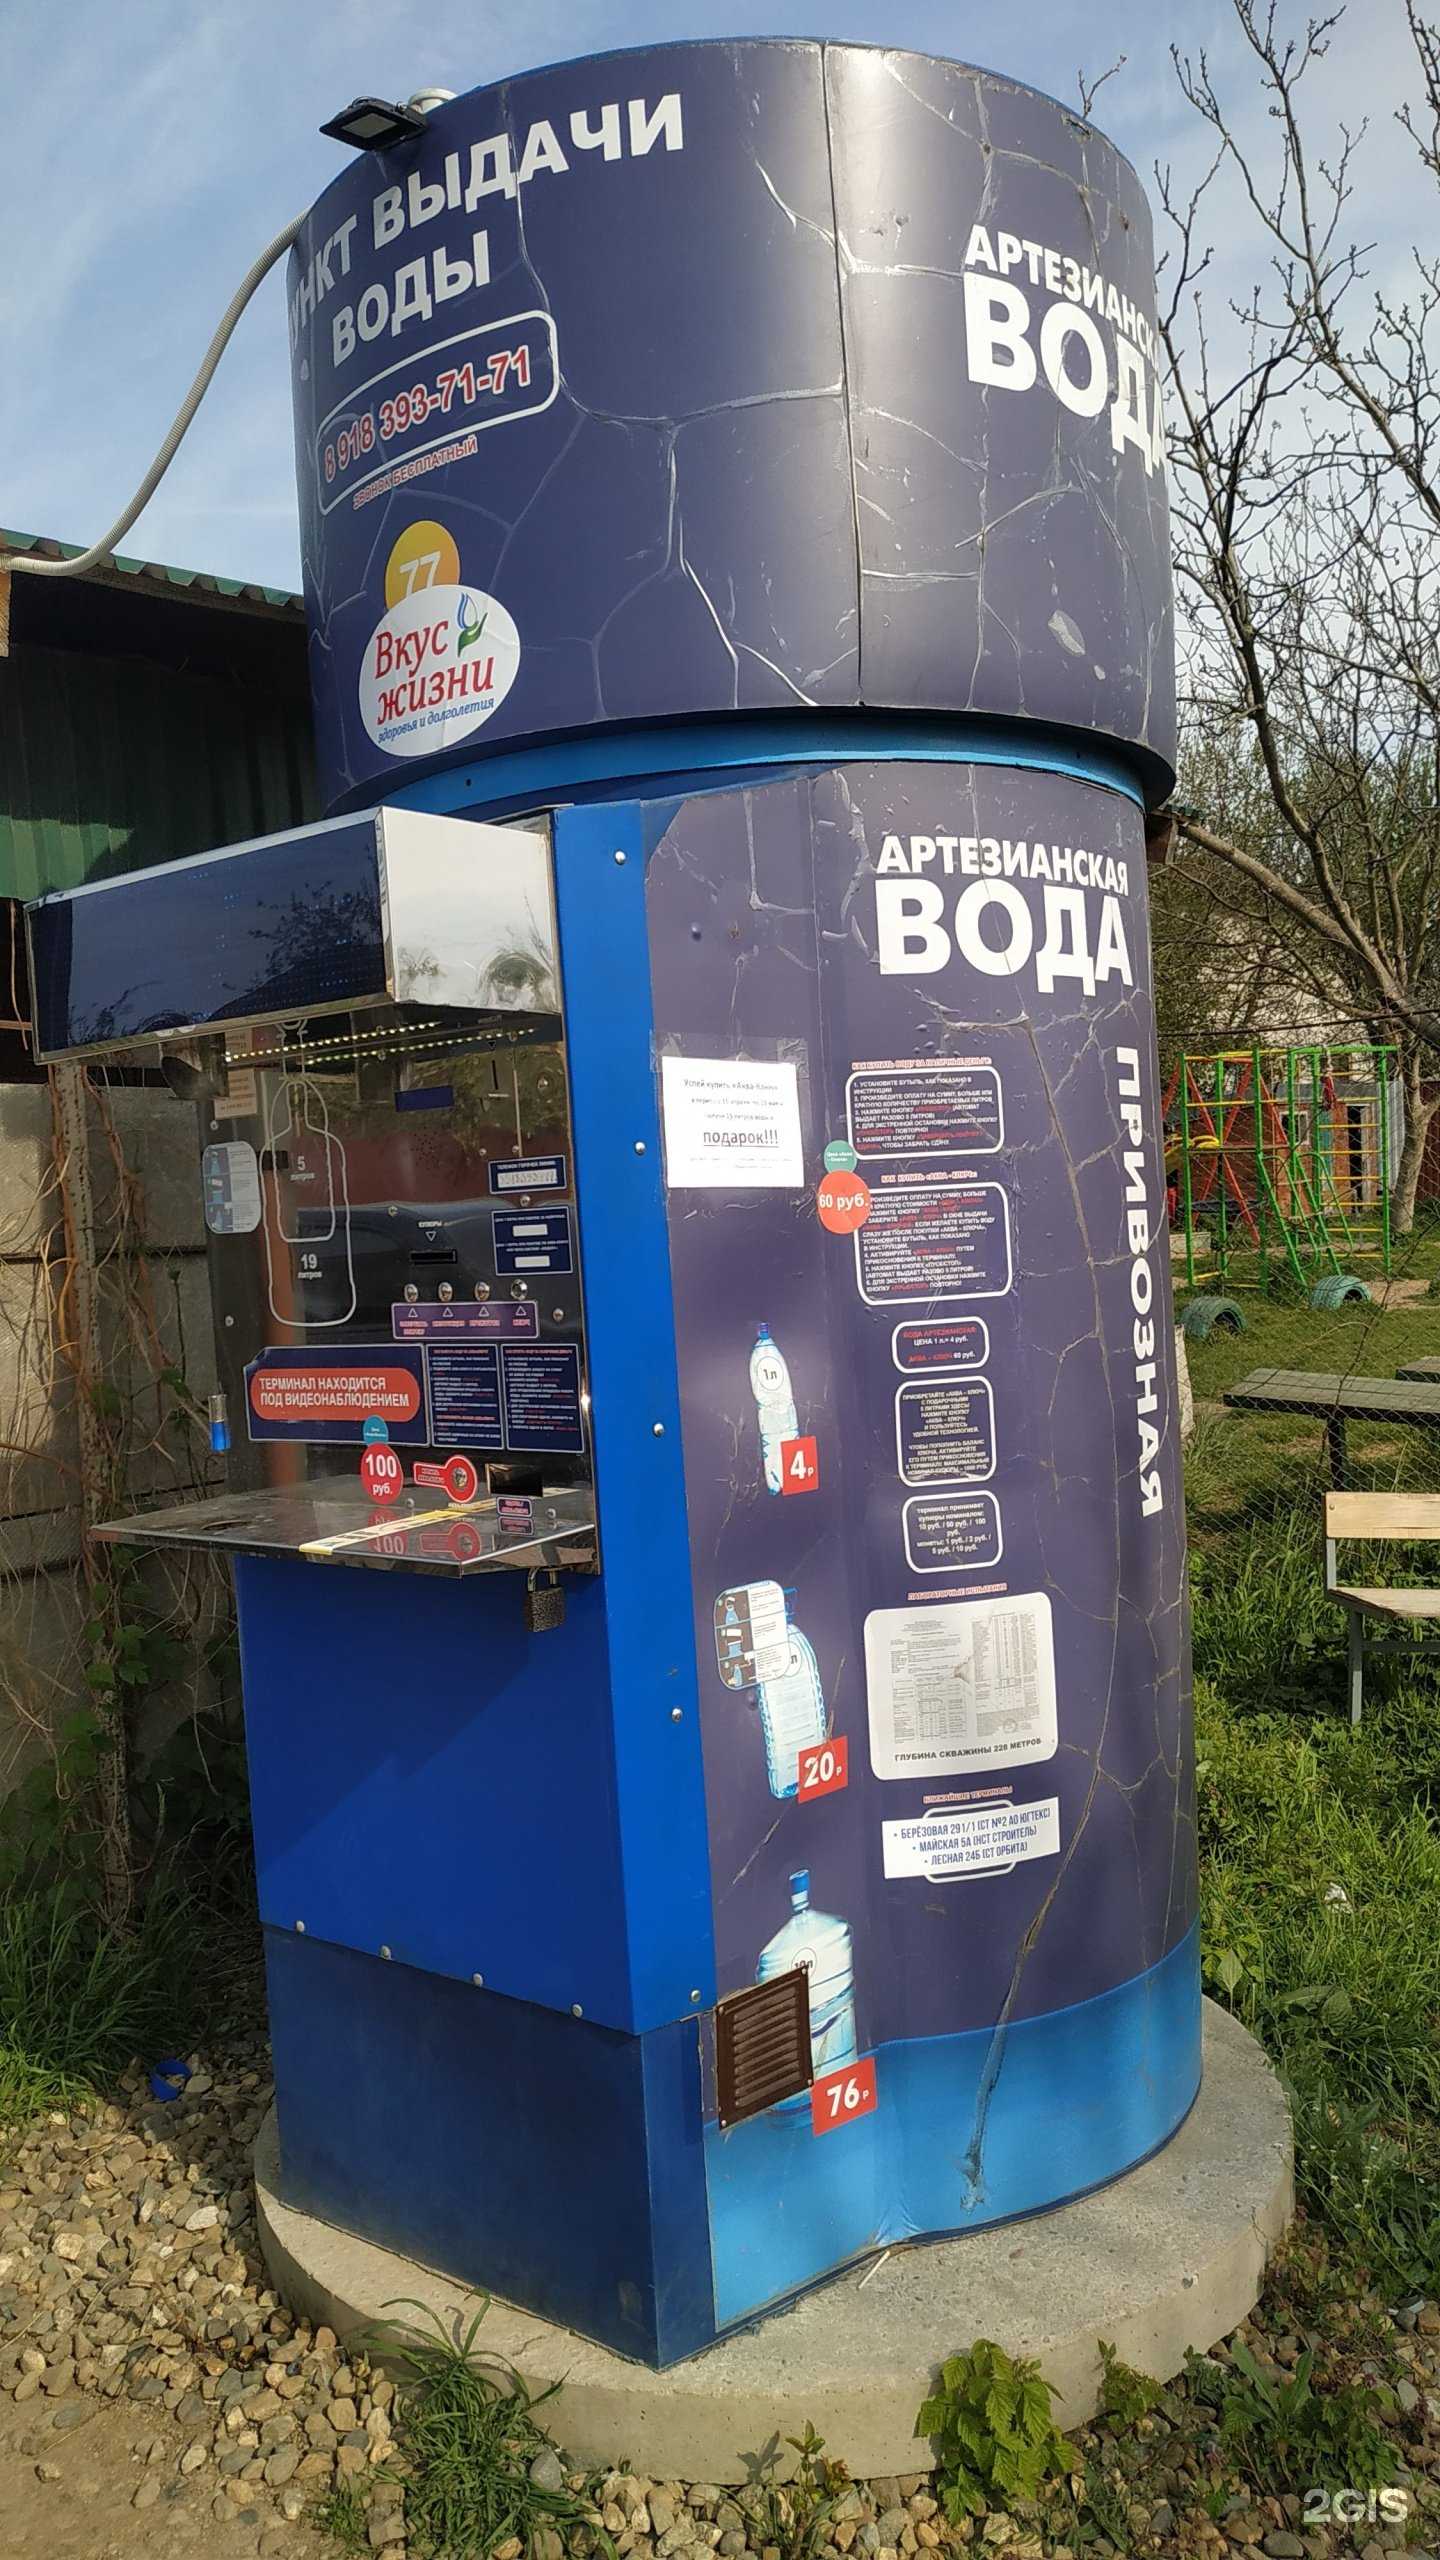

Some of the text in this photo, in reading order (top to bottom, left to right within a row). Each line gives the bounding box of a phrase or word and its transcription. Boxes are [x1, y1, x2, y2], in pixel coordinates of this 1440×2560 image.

[373, 94, 683, 250] ВЫДАЧИ
[332, 230, 491, 368] ВОДЫ
[965, 224, 1156, 362] АРТЕЗИАНСК
[325, 344, 530, 483] 8 918 393-71-71
[392, 433, 478, 487] БЕСПЛАТНЫЙ
[399, 551, 441, 598] 77
[374, 620, 449, 679] Вкус
[419, 714, 427, 729] и
[427, 698, 494, 726] долголетия
[876, 836, 1128, 896] АРТЕЗИАНСКАЯ
[875, 878, 1133, 996] ВОДА
[703, 1129, 779, 1147] подарок!!!
[297, 1156, 306, 1171] 5
[819, 1192, 869, 1211] 60 руб.
[301, 1254, 317, 1269] 19
[1116, 1046, 1163, 1518] ПРИВОЗНАЯ
[914, 1338, 932, 1346] ЦЕНА
[955, 1335, 968, 1343] руб.
[259, 1377, 386, 1392] ТЕРМИНАЛ НАХОДИТСЯ
[260, 1393, 409, 1408] ПОД ВИДЕОНАБЛЮДЕНИЕМ
[365, 1454, 397, 1478] 100
[372, 1483, 392, 1496] руб.
[895, 1751, 936, 1763] ГЛУБИНА
[940, 1745, 991, 1758] СКВАЖИНЫ
[1011, 1738, 1041, 1749] МЕТРОВ
[901, 1825, 948, 1841] БЕРЁЗОВАЯ
[951, 1820, 975, 1834] 291/1
[920, 1838, 959, 1854] МАЙСКАЯ
[992, 1826, 1037, 1843] СТРОИТЕЛЬ)
[931, 1851, 963, 1866] ЛЕСНАЯ
[996, 1841, 1027, 1857] ОРБИТА)
